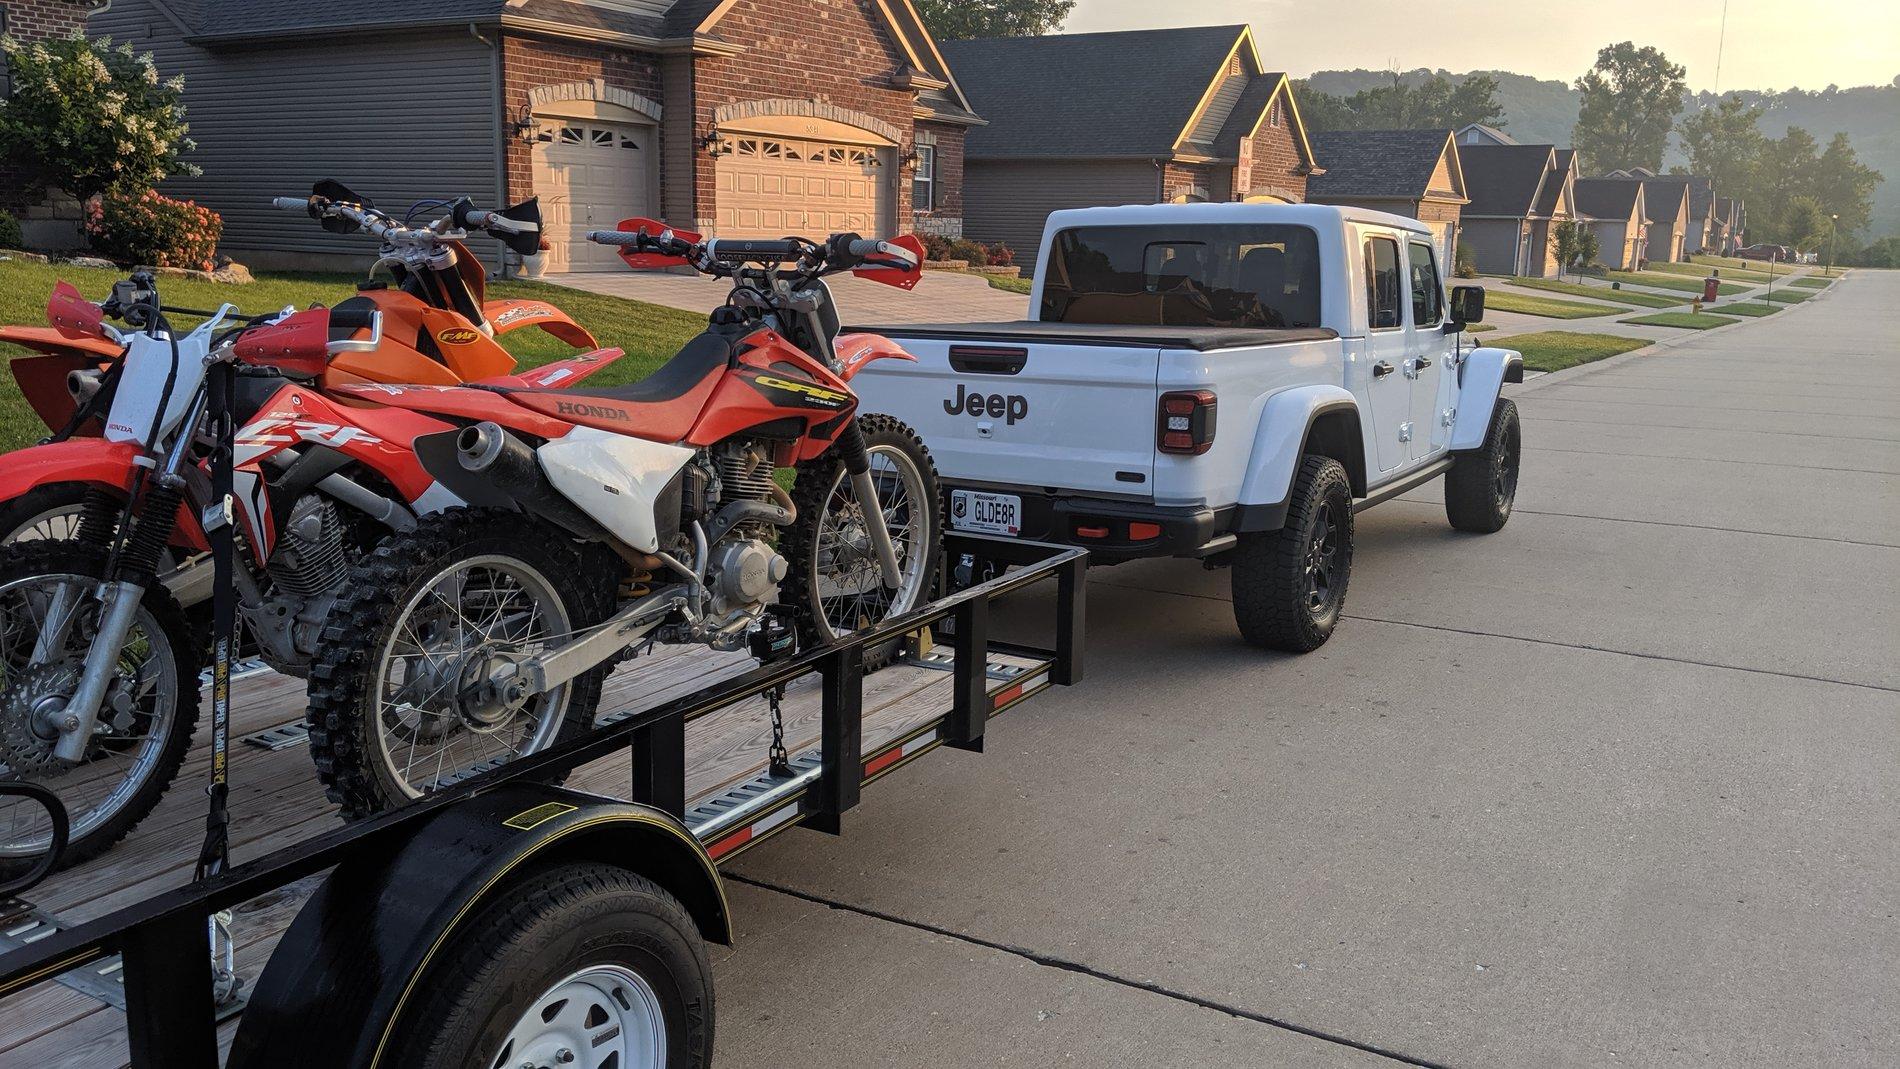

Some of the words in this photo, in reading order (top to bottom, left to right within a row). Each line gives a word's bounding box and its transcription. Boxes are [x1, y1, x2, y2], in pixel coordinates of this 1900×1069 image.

[441, 331, 477, 341] FMF
[755, 375, 848, 401] CRF
[556, 401, 631, 421] HONDA
[943, 384, 1028, 425] Jeep
[108, 424, 133, 434] HONDA
[974, 500, 1015, 526] GLDE8R
